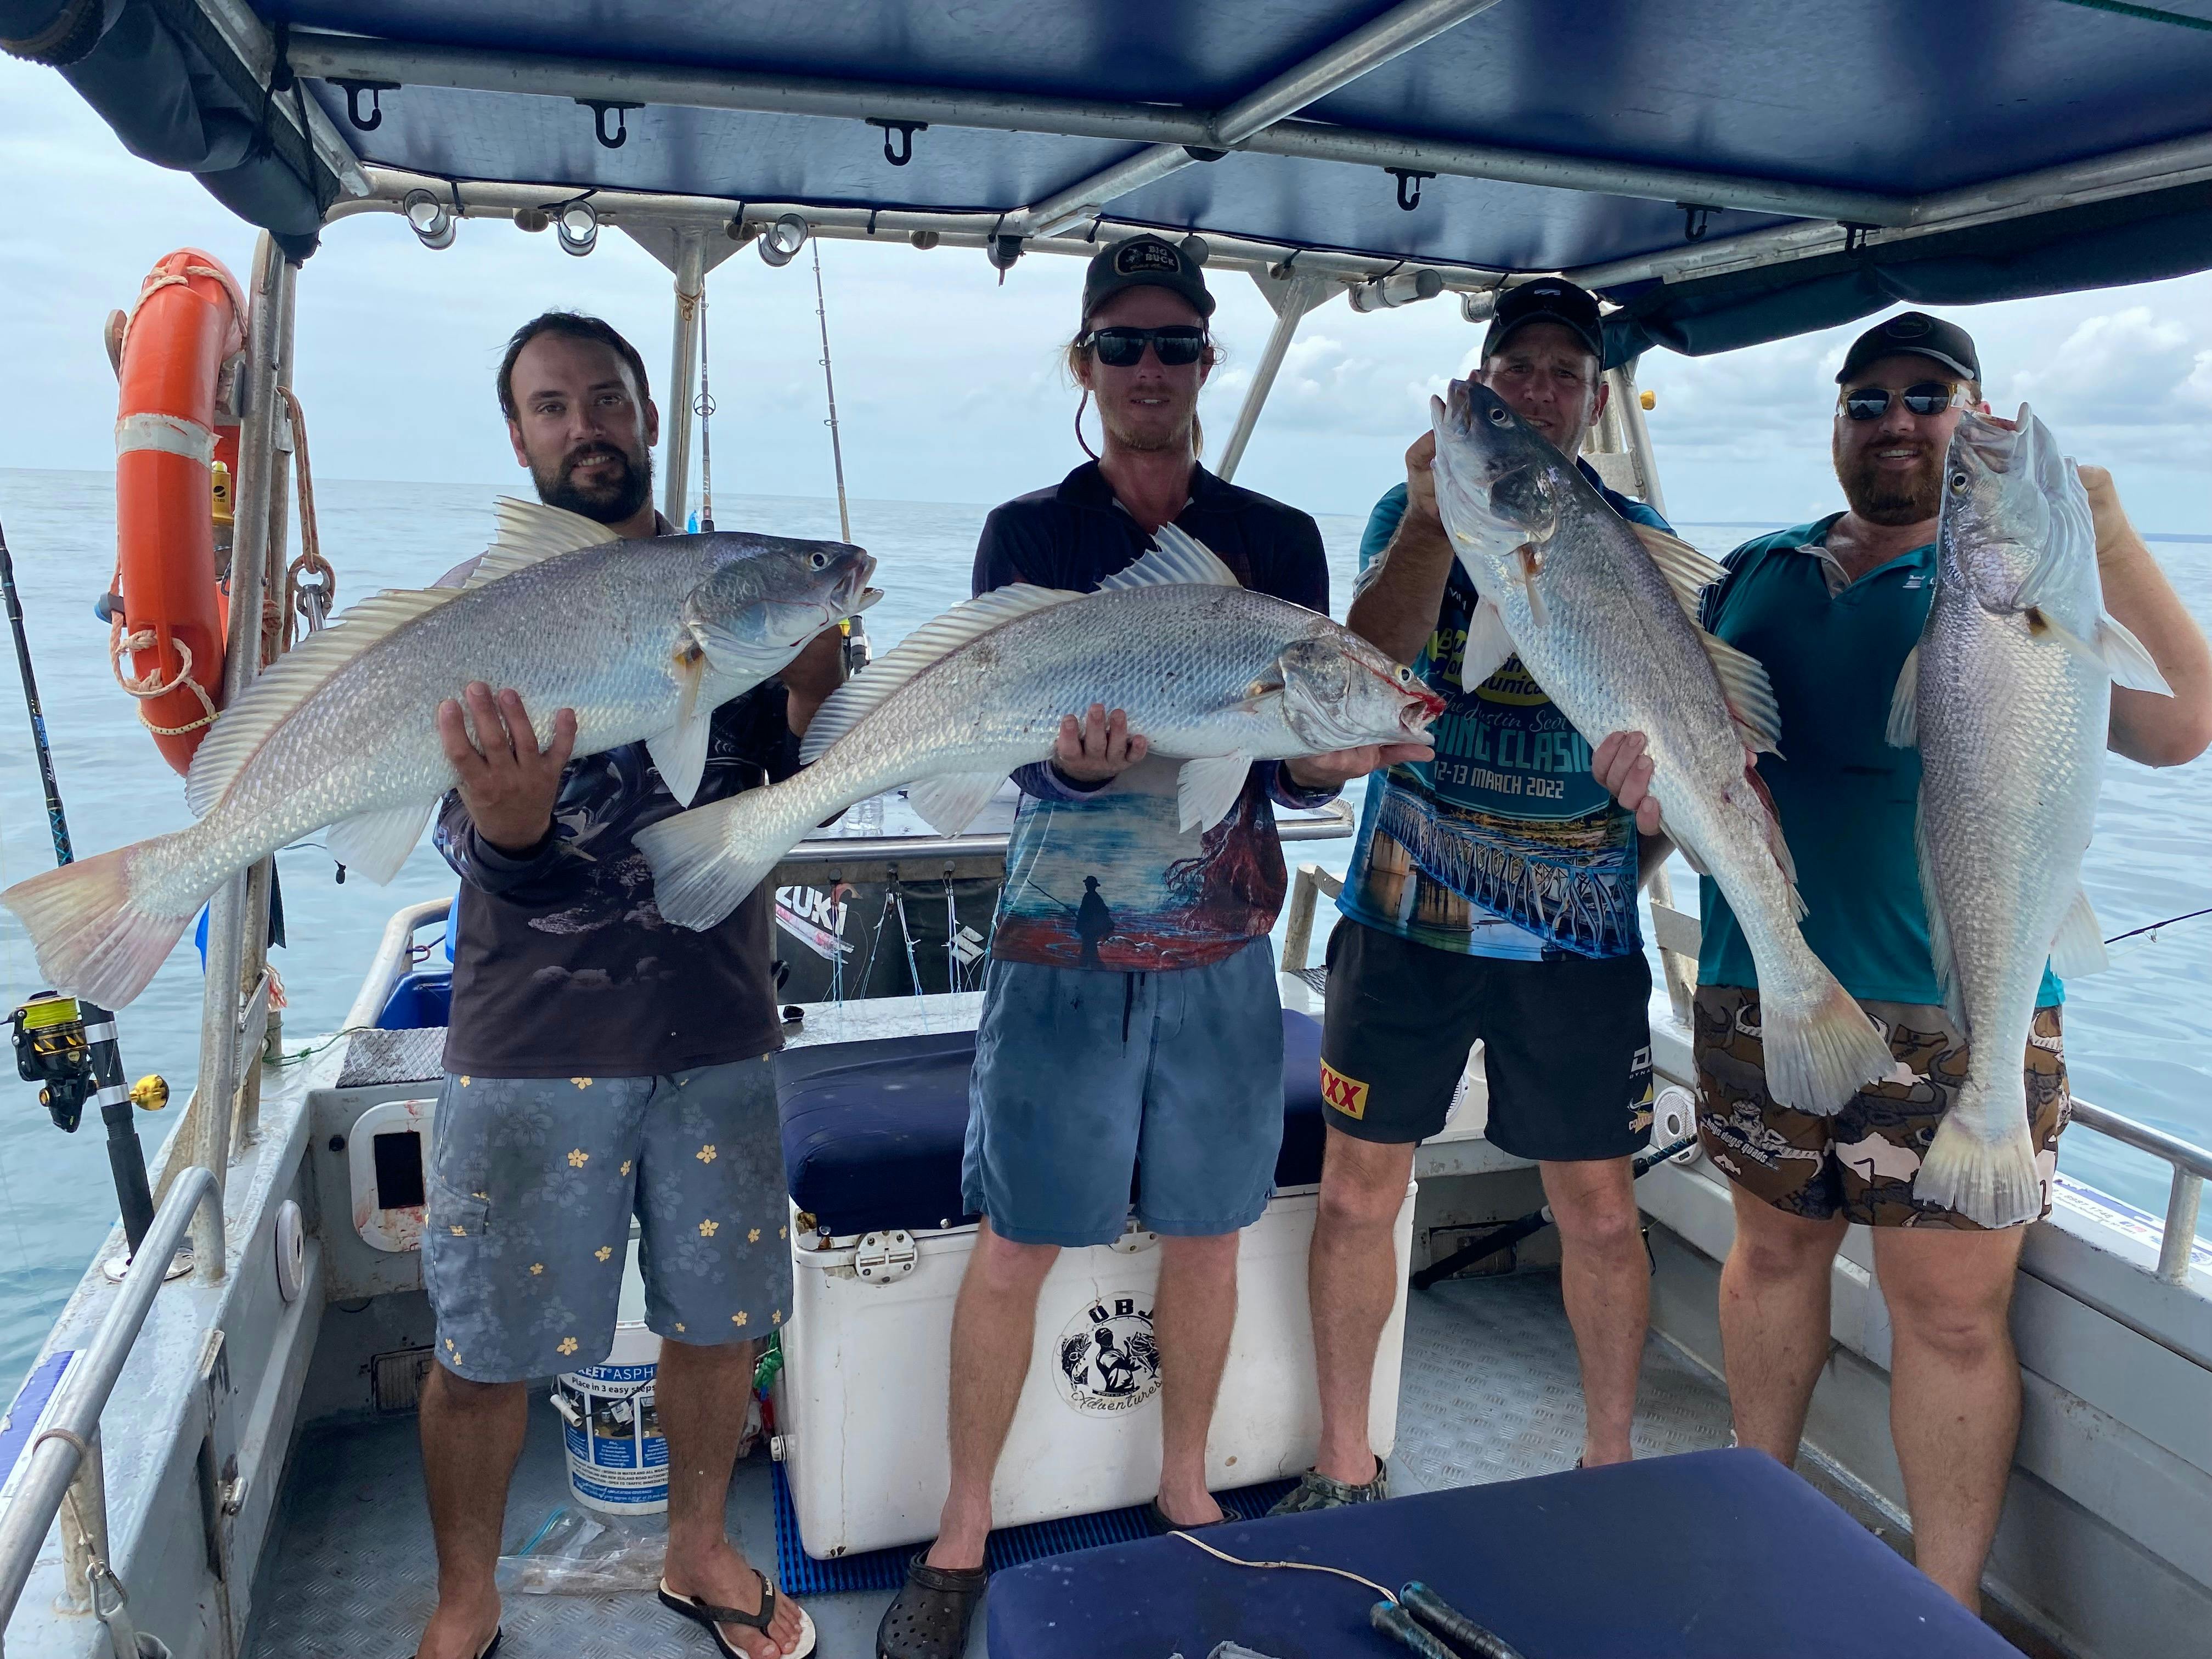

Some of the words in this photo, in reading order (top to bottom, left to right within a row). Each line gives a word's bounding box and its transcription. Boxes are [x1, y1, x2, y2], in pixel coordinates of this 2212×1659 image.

[1146, 253, 1175, 266] BUCK
[1471, 767, 1522, 795] MARCH
[1526, 776, 1564, 799] 2022
[613, 1367, 653, 1380] ASPH
[572, 1377, 590, 1389] Place
[592, 1383, 599, 1391] in
[608, 1386, 629, 1395] easy
[631, 1384, 656, 1393] steps
